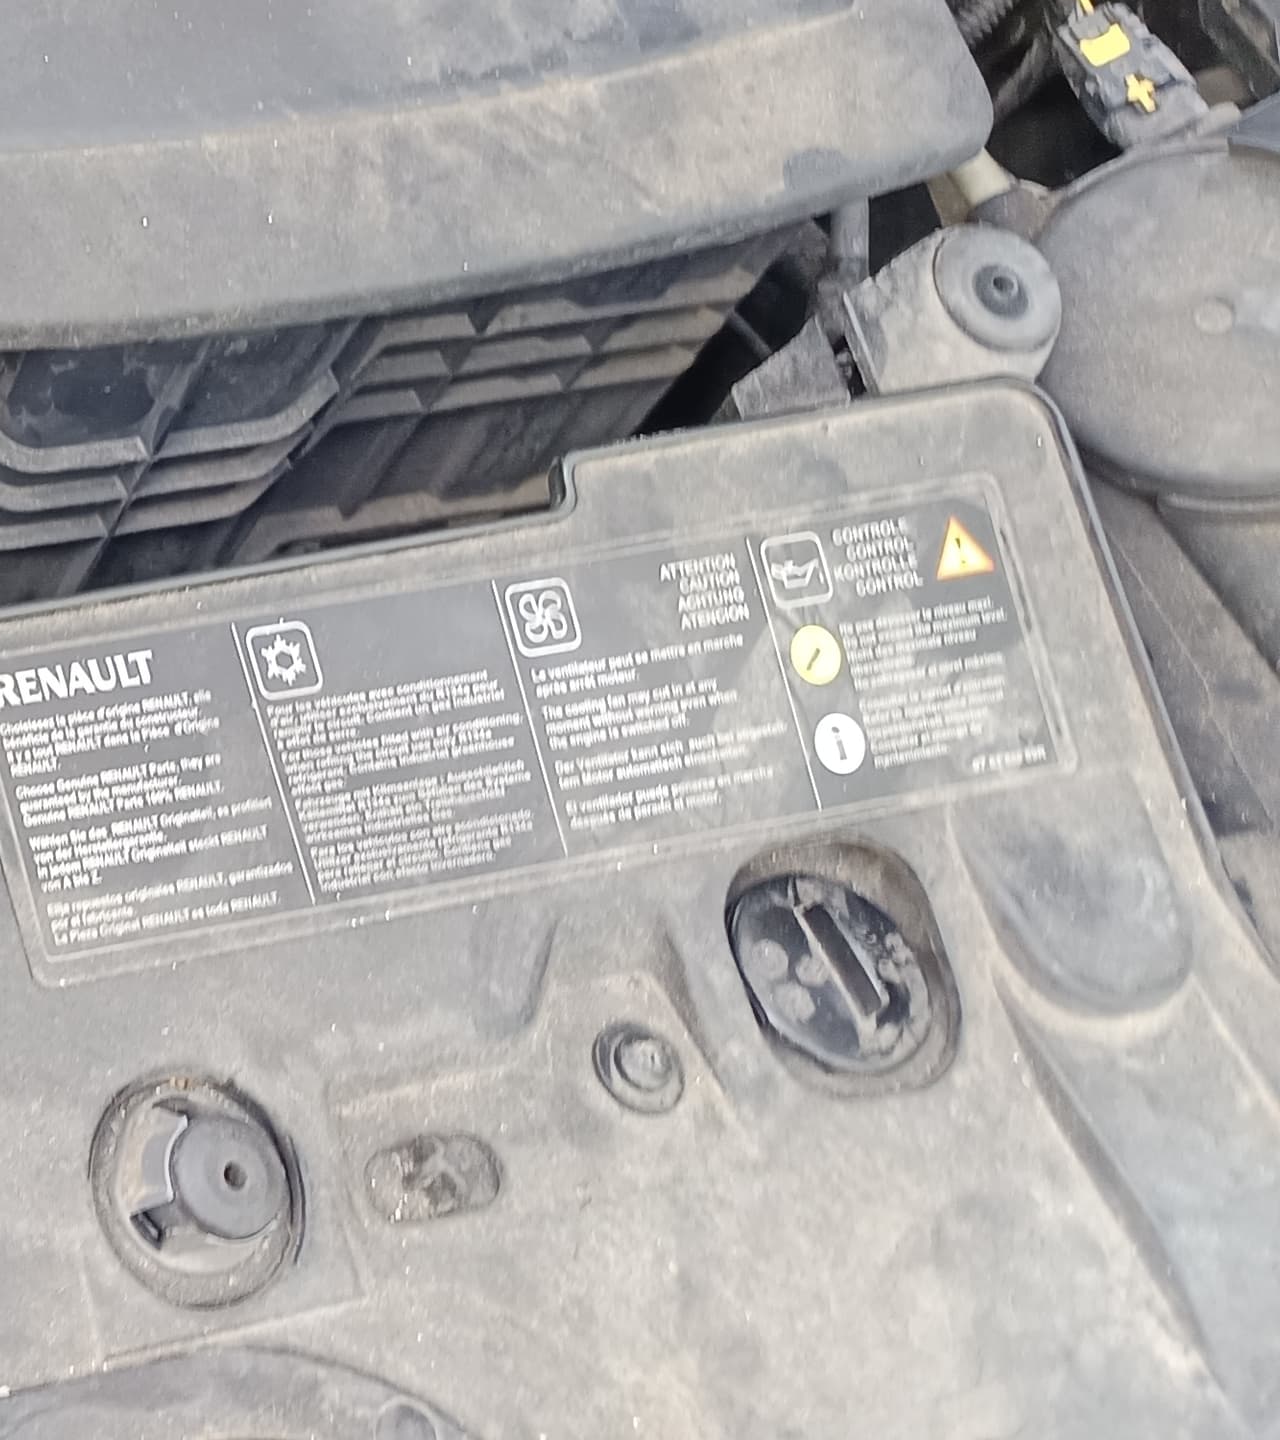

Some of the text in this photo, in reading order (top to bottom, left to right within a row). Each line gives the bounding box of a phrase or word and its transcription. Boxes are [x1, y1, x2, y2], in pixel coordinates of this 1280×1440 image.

[660, 553, 736, 581] ATTENTION
[679, 569, 740, 594] CAUTION
[678, 586, 745, 612] ACHTUNG
[54, 735, 102, 756] RENAULT
[99, 764, 147, 785] RENAULT
[67, 798, 114, 819] RENAULT
